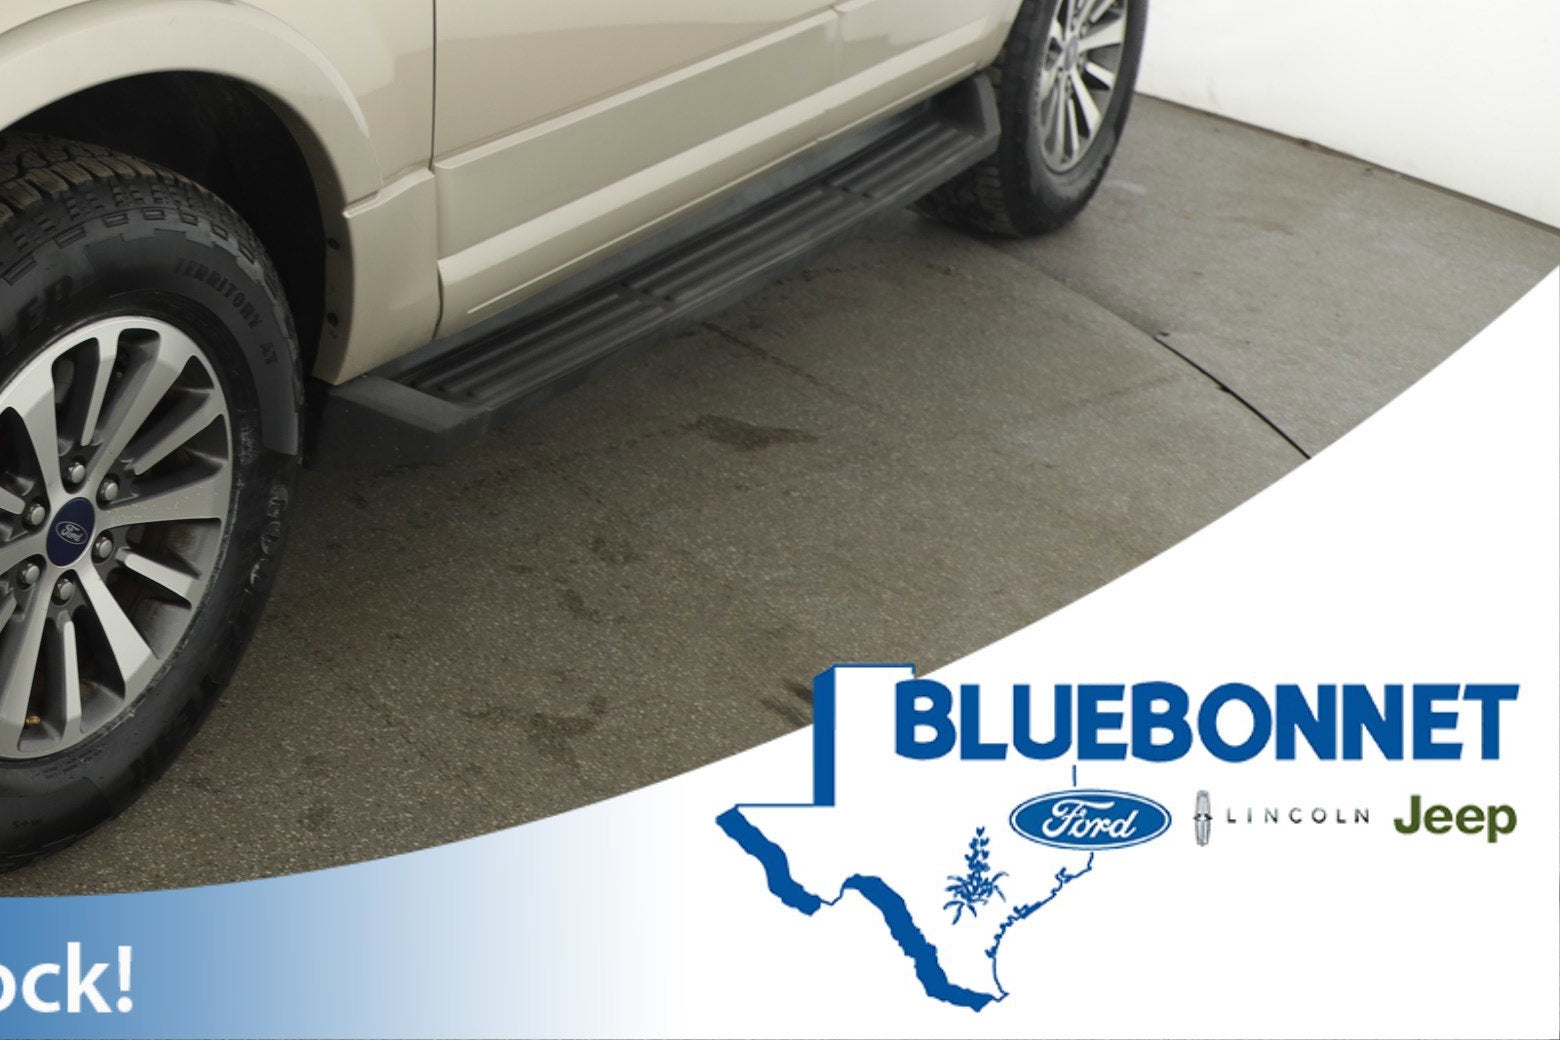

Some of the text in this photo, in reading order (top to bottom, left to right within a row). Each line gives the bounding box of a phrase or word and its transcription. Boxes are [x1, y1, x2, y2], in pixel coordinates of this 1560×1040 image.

[174, 257, 279, 365] TERRITORY AT
[60, 523, 85, 542] Ford
